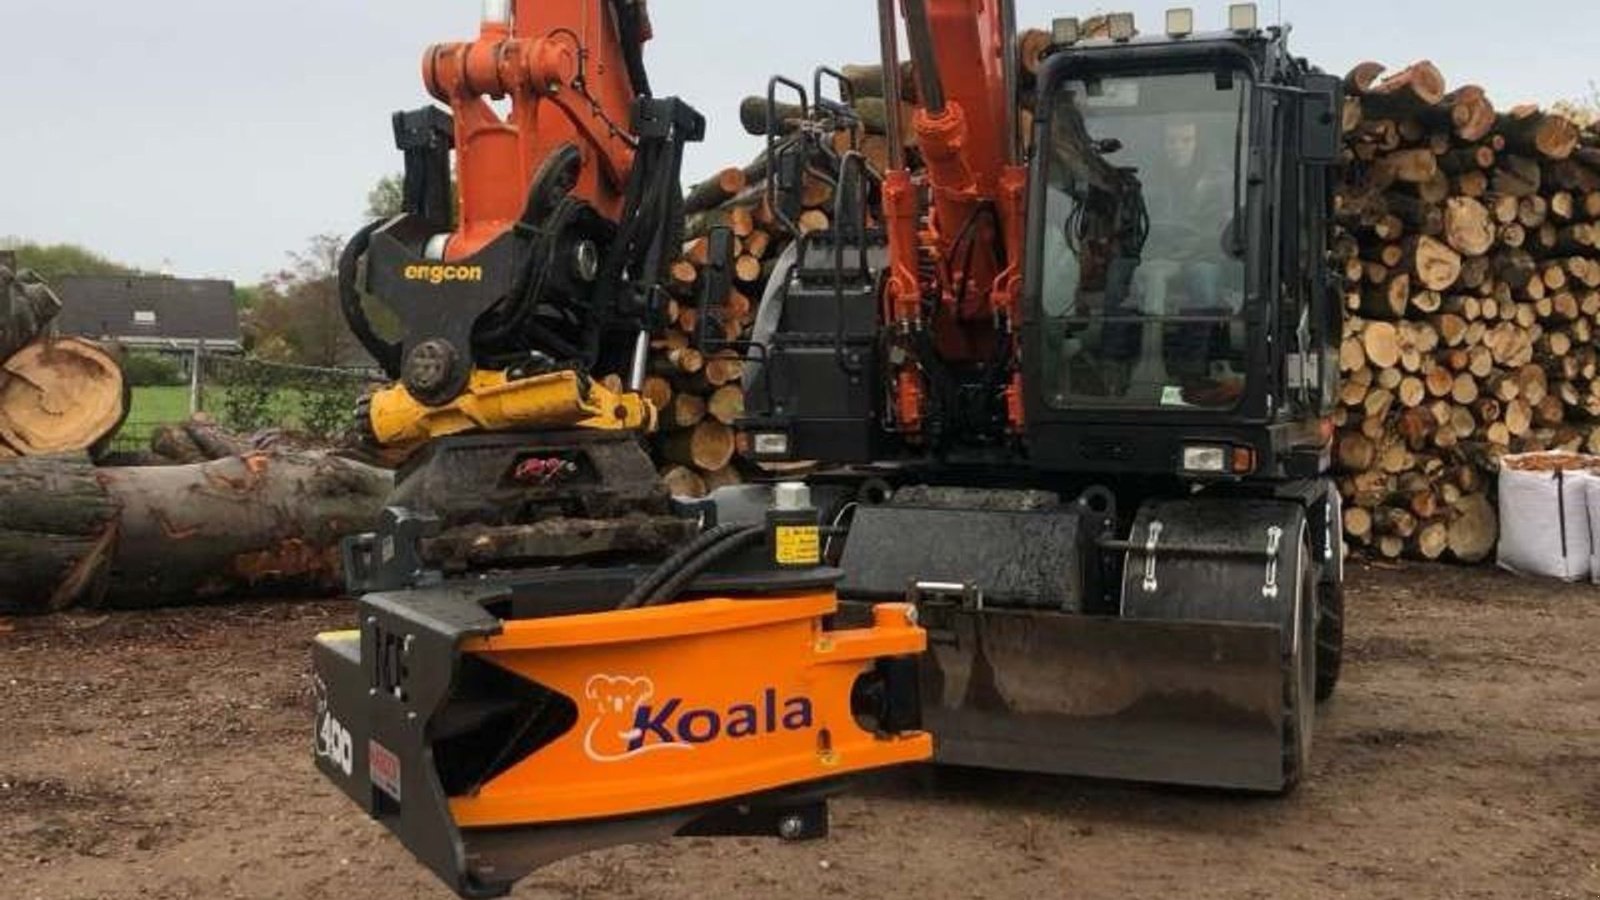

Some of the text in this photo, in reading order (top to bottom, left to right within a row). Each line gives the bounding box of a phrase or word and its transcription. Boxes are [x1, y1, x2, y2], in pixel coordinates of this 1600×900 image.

[404, 265, 482, 284] engcon
[320, 711, 353, 776] 400
[627, 687, 812, 751] Koala
